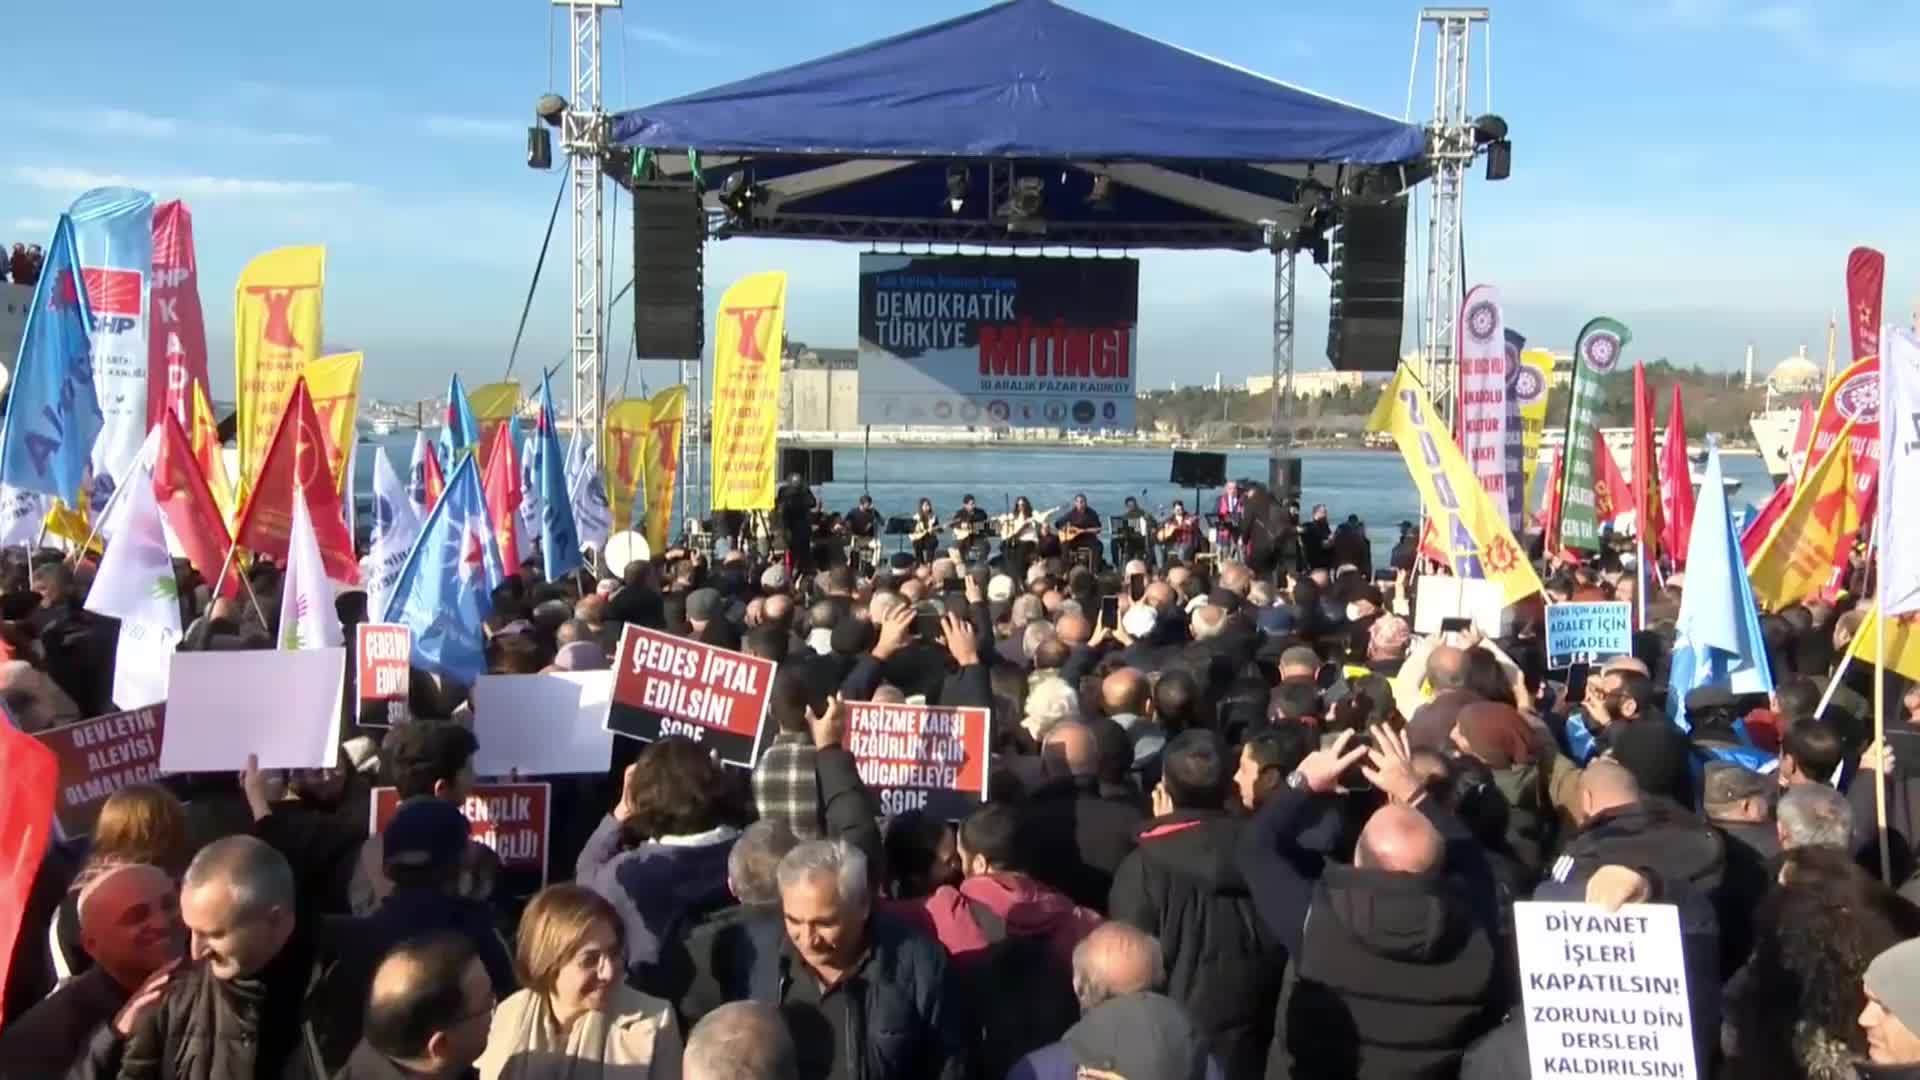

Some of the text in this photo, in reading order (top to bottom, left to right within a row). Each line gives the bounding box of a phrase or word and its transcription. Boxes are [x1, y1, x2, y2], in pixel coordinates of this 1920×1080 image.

[876, 289, 1016, 320] DEMOKRATİK
[875, 315, 1131, 378] TÜRKİYE MİTİNGİ
[994, 380, 1037, 391] ARALIK
[1039, 381, 1079, 392] PAZAR
[1551, 615, 1627, 633] ADALET İÇİN
[1555, 636, 1621, 650] MÜCADELE
[632, 637, 758, 695] ÇEDES İPTAL
[643, 677, 735, 726] EDİLSİN!
[72, 708, 156, 748] DEVLETİN
[851, 705, 966, 739] FAŞİZME KARŞI
[87, 732, 156, 772] ALEVİSİ
[850, 731, 965, 763] ÖZGÜRLÜK İÇİN
[65, 762, 162, 805] OLMAYACA
[458, 793, 531, 828] ENÇLİK
[880, 789, 929, 815] SGDF
[1546, 910, 1648, 934] DİYANET
[1564, 939, 1636, 967] İŞLERİ
[1530, 972, 1680, 995] KAPATILSIN!
[1533, 1004, 1684, 1028] ZORUNLU DİN
[1561, 1032, 1660, 1051] DERSLERİ
[1543, 1056, 1684, 1079] KALDIRILSIN!
